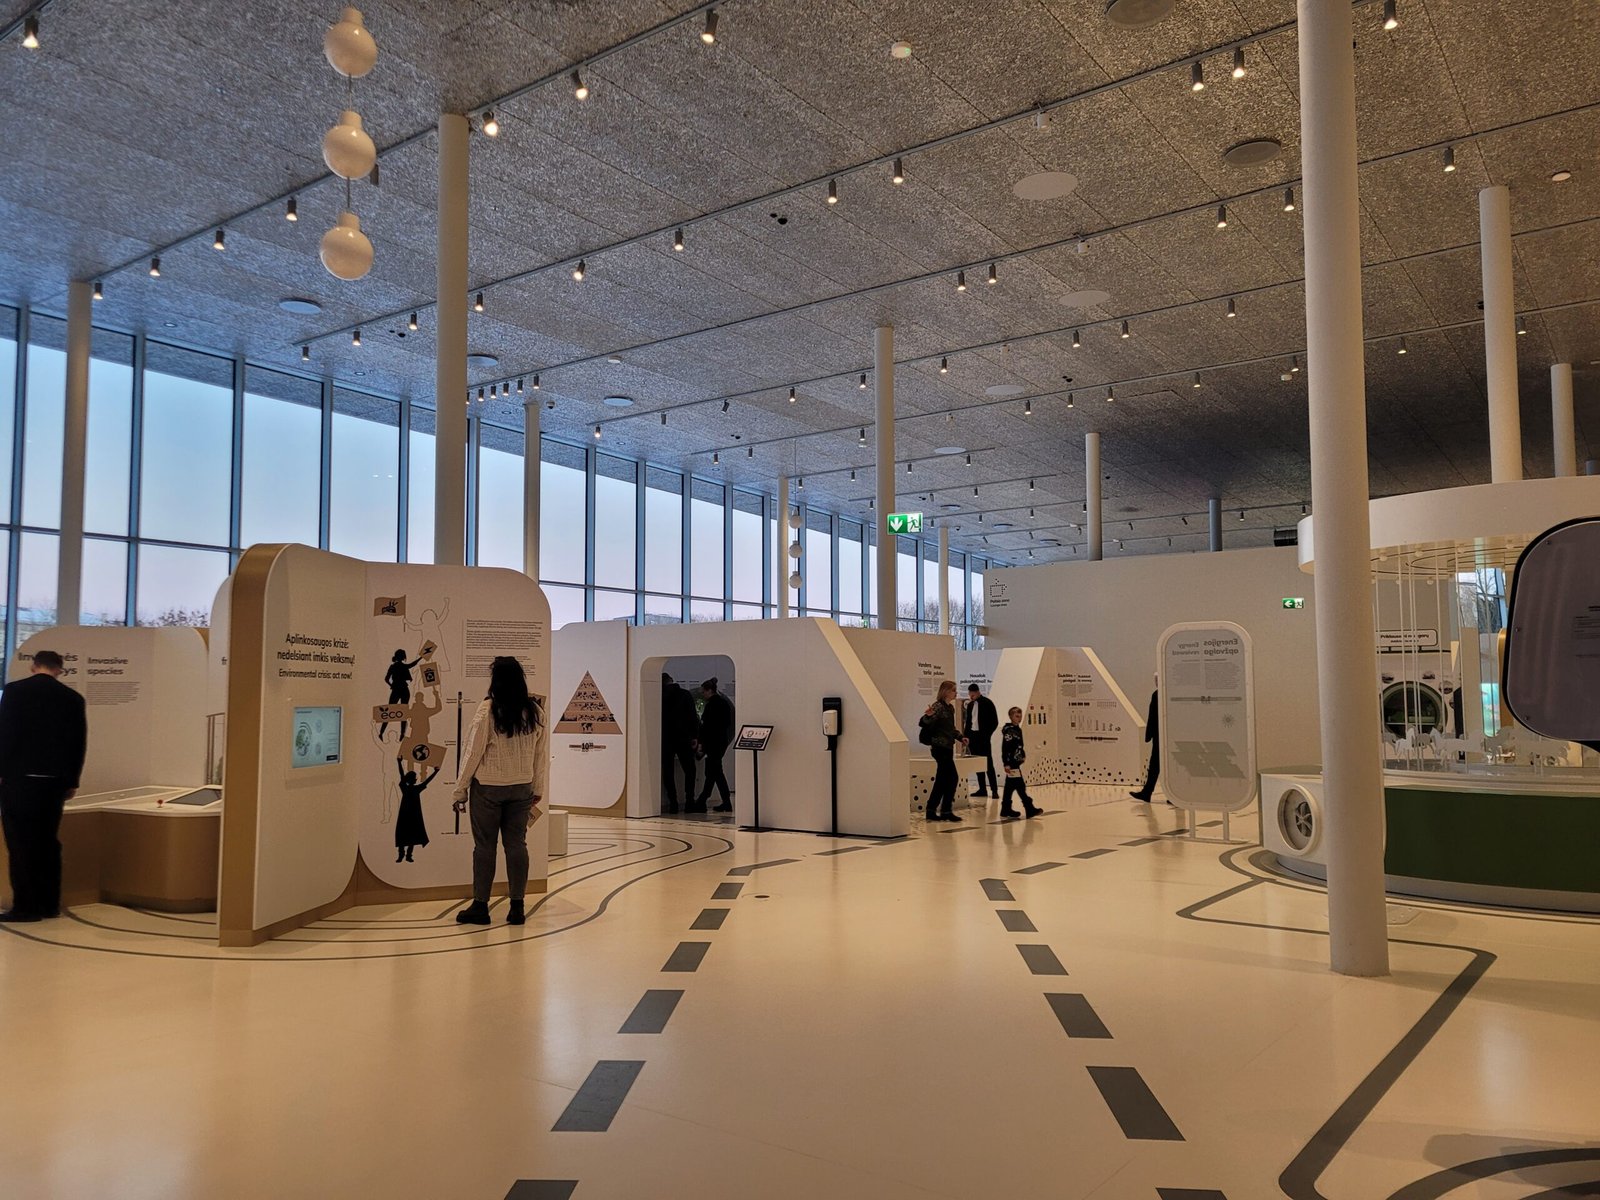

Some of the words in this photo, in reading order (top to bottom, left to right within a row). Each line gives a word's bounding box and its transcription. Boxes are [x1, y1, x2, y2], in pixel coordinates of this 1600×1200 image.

[285, 633, 332, 649] Aplinkosaugos
[277, 649, 312, 661] nedelsiant
[312, 652, 329, 662] imkis
[88, 668, 124, 676] species
[279, 668, 317, 678] Environmental
[381, 710, 403, 719] eco
